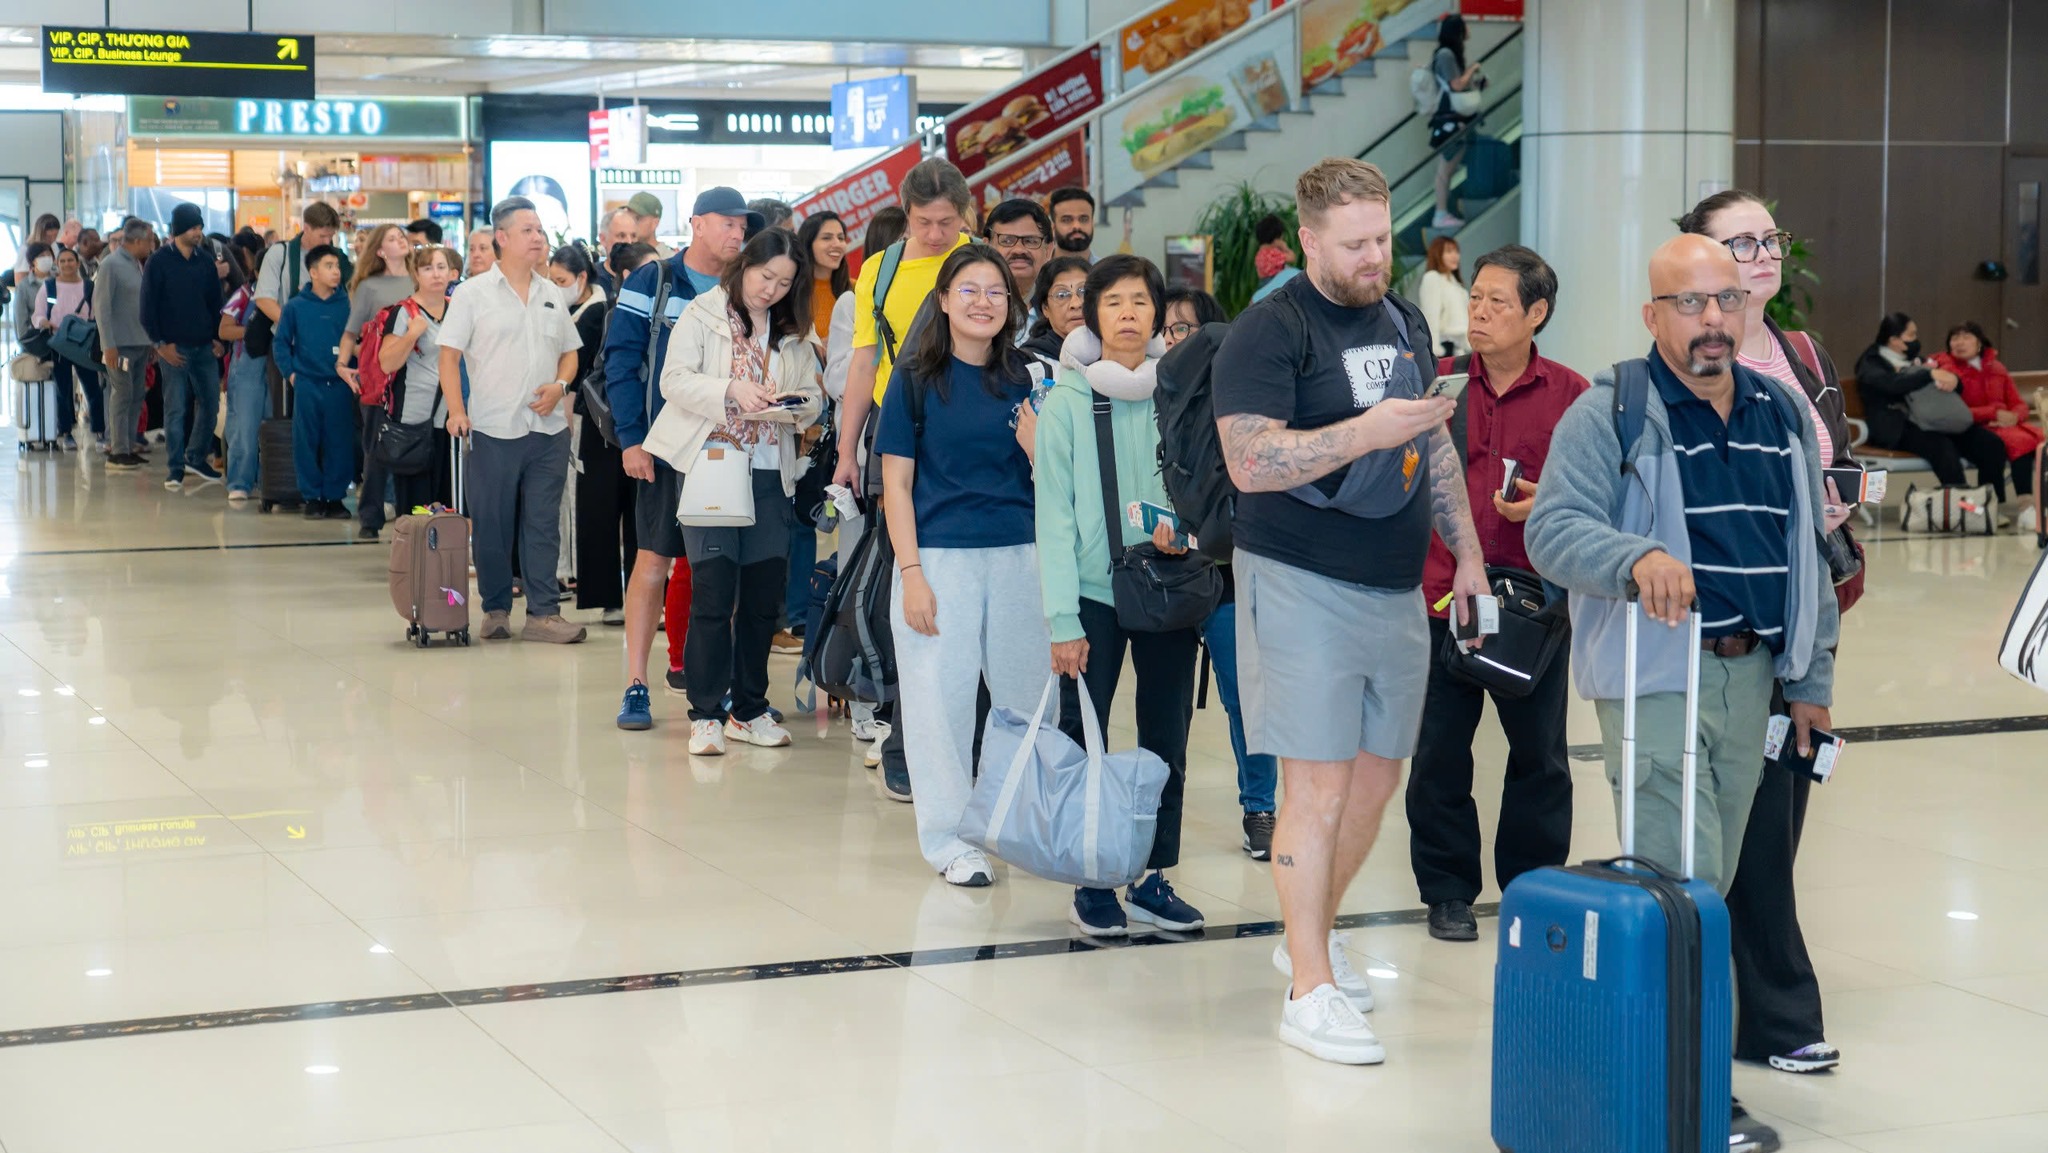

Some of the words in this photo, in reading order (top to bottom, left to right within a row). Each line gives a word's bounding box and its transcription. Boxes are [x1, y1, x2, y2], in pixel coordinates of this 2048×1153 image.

[50, 31, 76, 46] VIP,
[78, 32, 104, 47] CIP,
[166, 35, 190, 49] GIA
[50, 47, 72, 59] VIP,
[73, 48, 96, 60] CIP,
[97, 48, 143, 61] Business
[144, 49, 182, 63] Lounge
[238, 101, 382, 134] PRESTO
